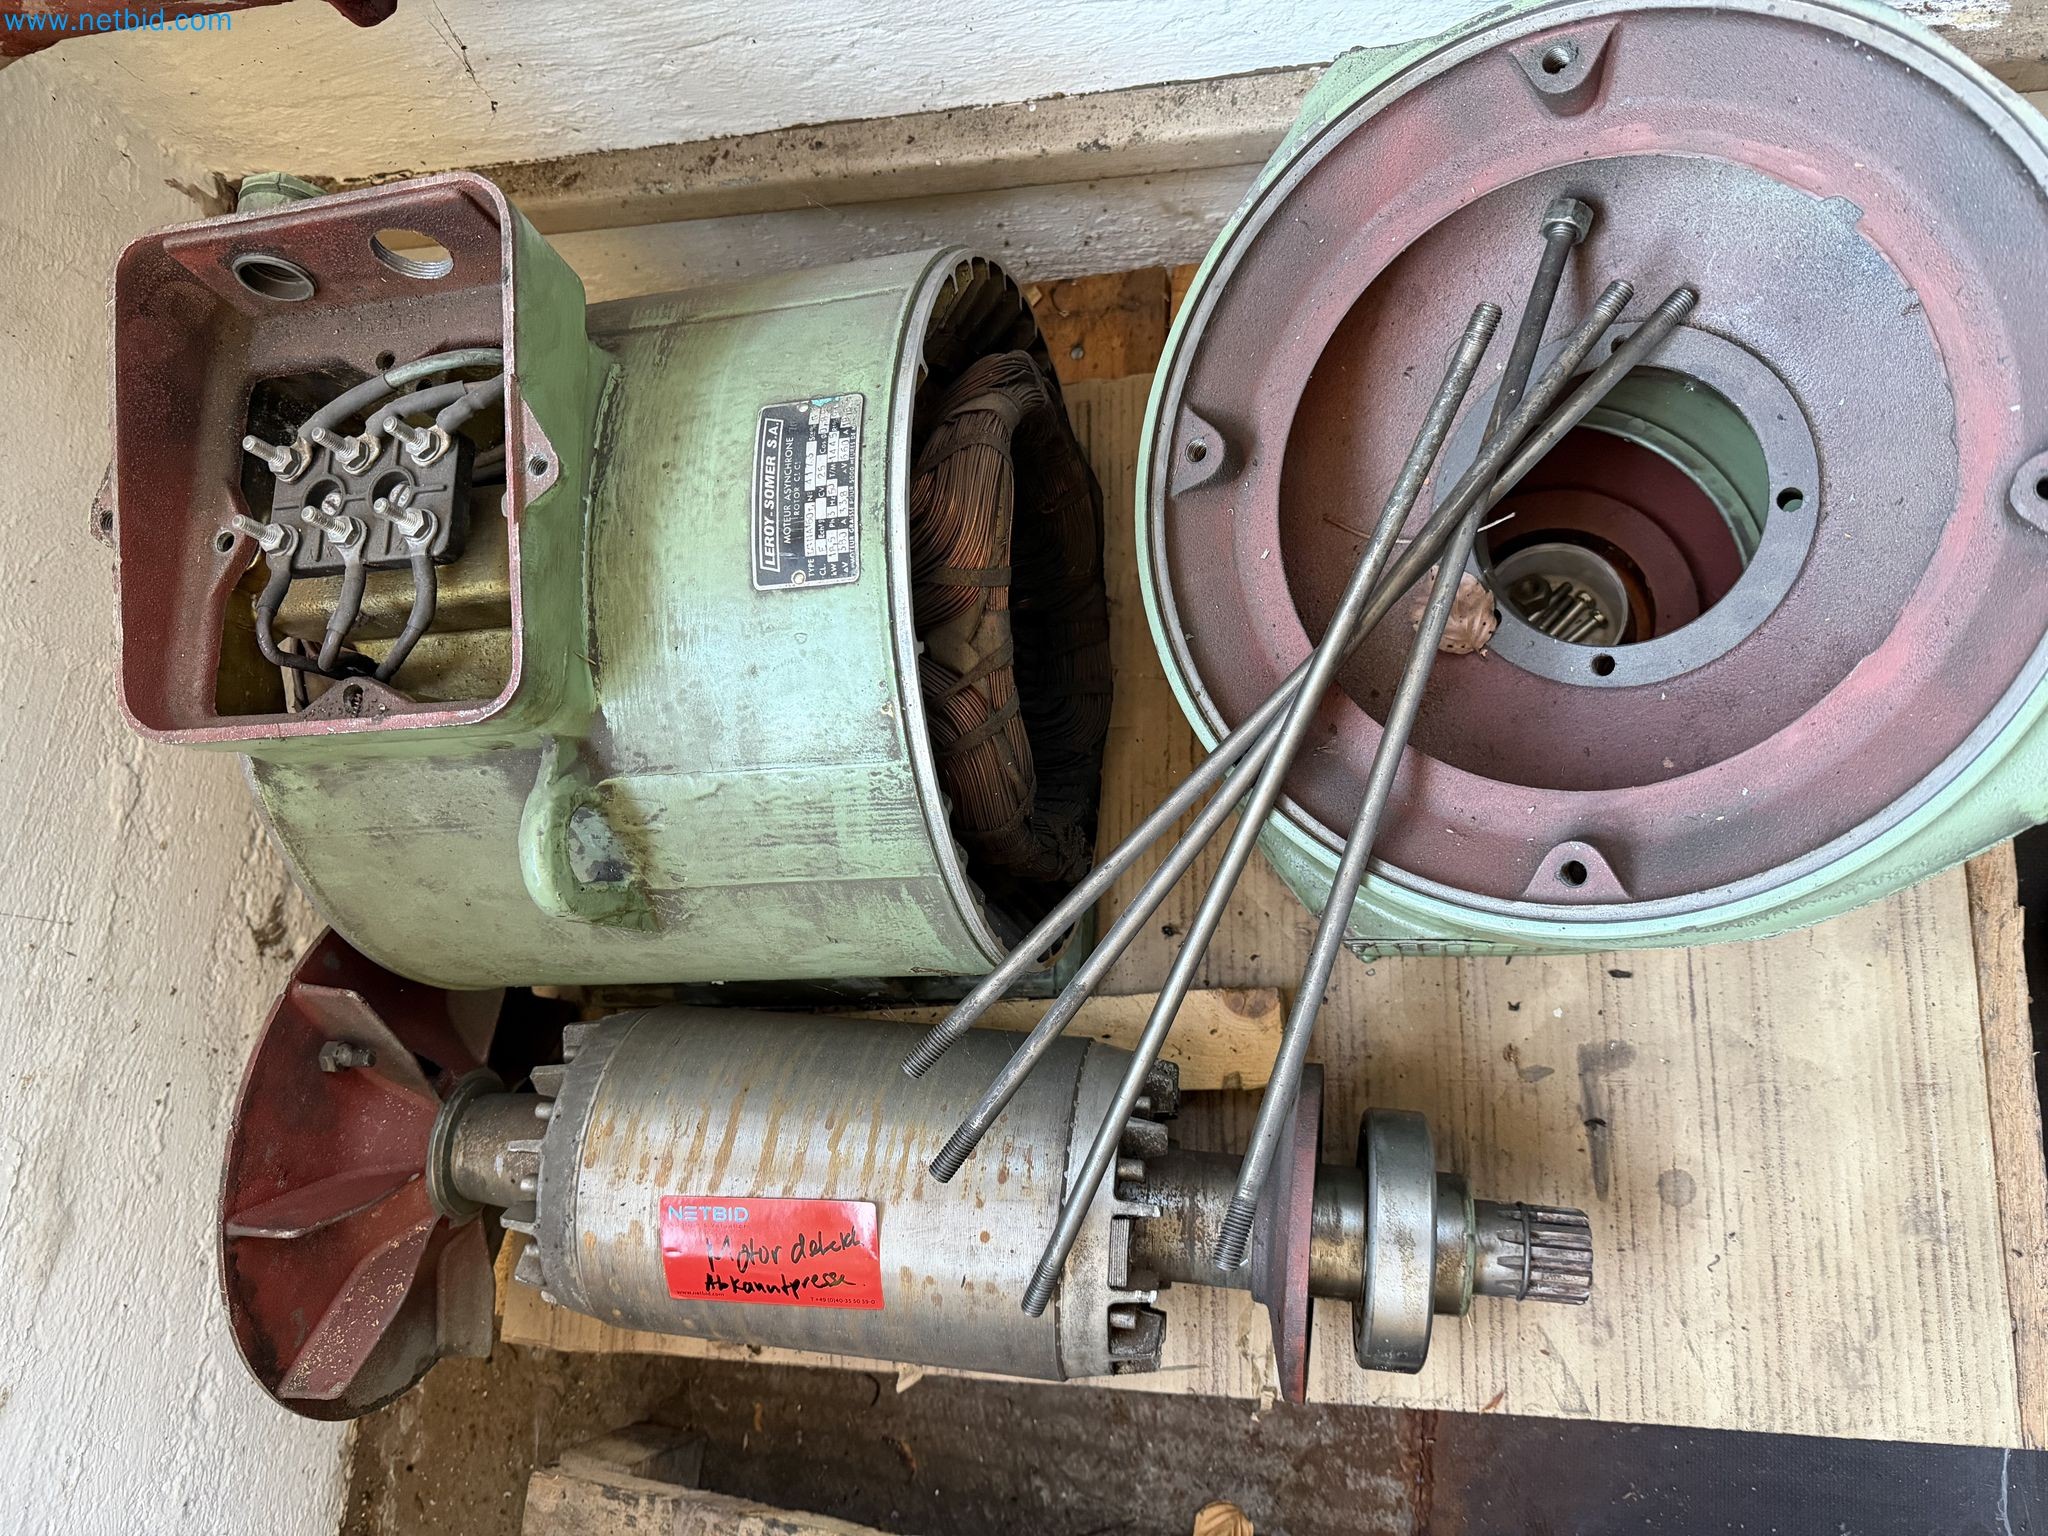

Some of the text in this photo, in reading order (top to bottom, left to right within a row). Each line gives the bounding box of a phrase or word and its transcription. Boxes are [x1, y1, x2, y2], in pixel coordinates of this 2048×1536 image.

[829, 463, 837, 478] T/M
[764, 422, 779, 566] LEROY-SOMER S.A.
[784, 437, 794, 544] MOTEUR ASYNCHRONE
[819, 487, 825, 497] CV
[668, 1206, 749, 1222] NETBID
